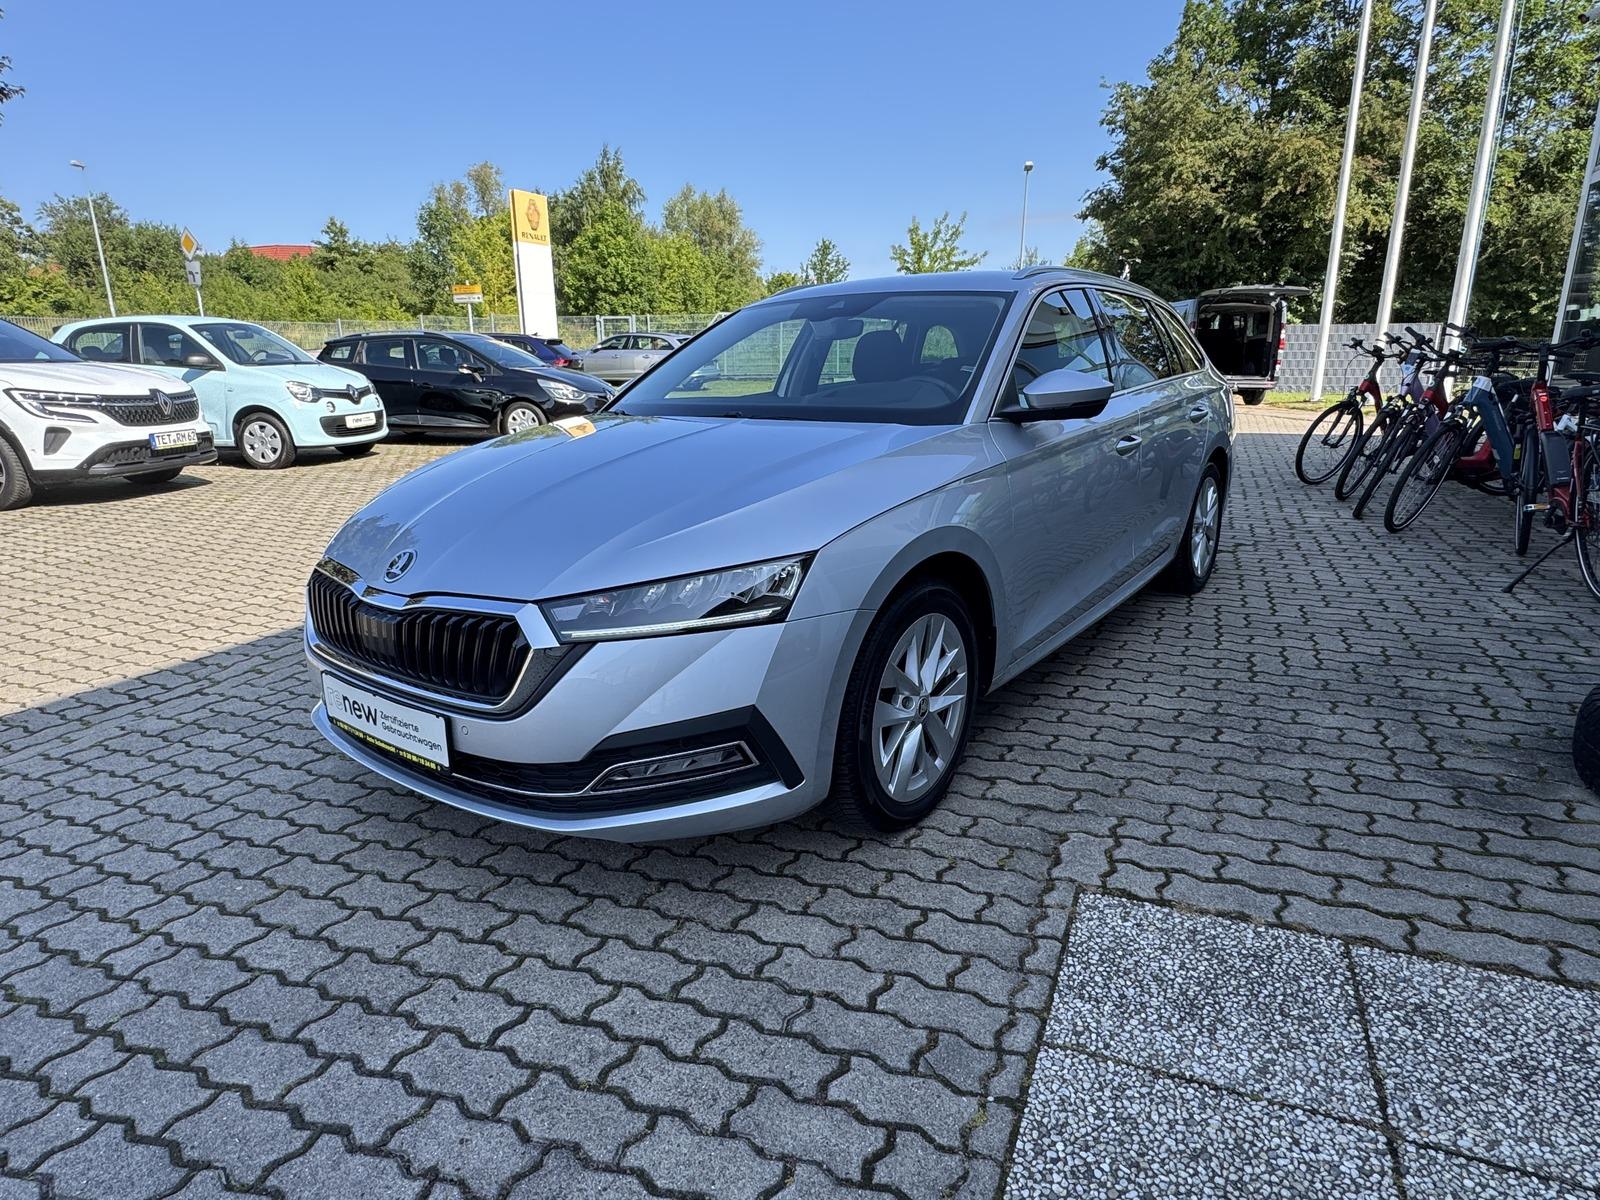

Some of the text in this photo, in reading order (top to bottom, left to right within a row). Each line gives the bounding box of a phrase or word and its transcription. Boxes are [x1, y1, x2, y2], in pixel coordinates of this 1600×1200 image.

[521, 231, 547, 241] RENAULT
[155, 430, 196, 445] TET RM 62
[380, 710, 419, 733] Zertifizierte
[381, 721, 442, 752] Gebrauchtwagen
